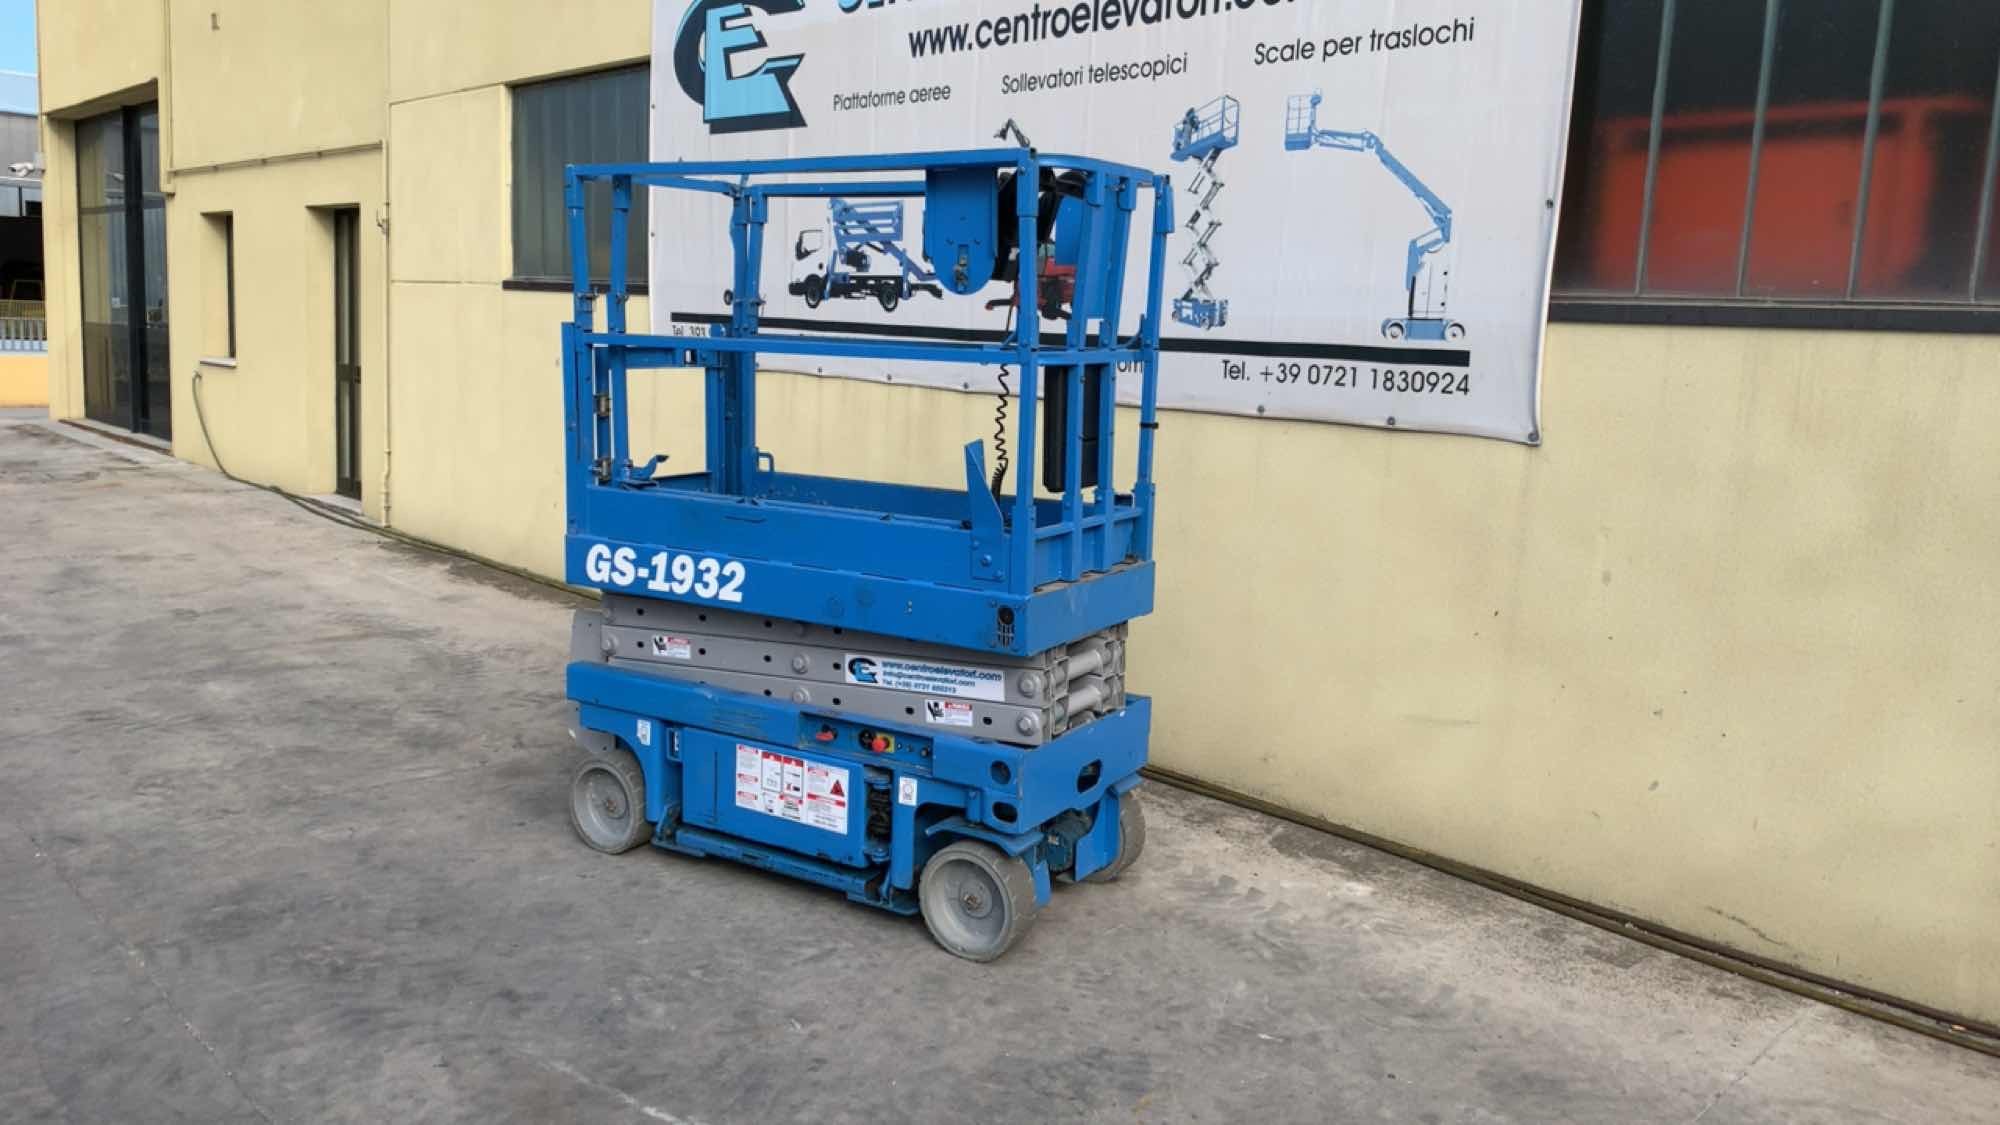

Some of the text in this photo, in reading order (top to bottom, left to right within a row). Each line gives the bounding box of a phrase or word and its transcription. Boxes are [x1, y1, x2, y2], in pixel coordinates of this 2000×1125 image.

[1254, 17, 1475, 65] Scale per traslochi
[1001, 52, 1188, 95] Sollevatori telescopici
[833, 85, 952, 112] Piattaforme aeree
[1221, 359, 1471, 396] Tel. +39 0721 1830924
[585, 543, 747, 603] GS-1932
